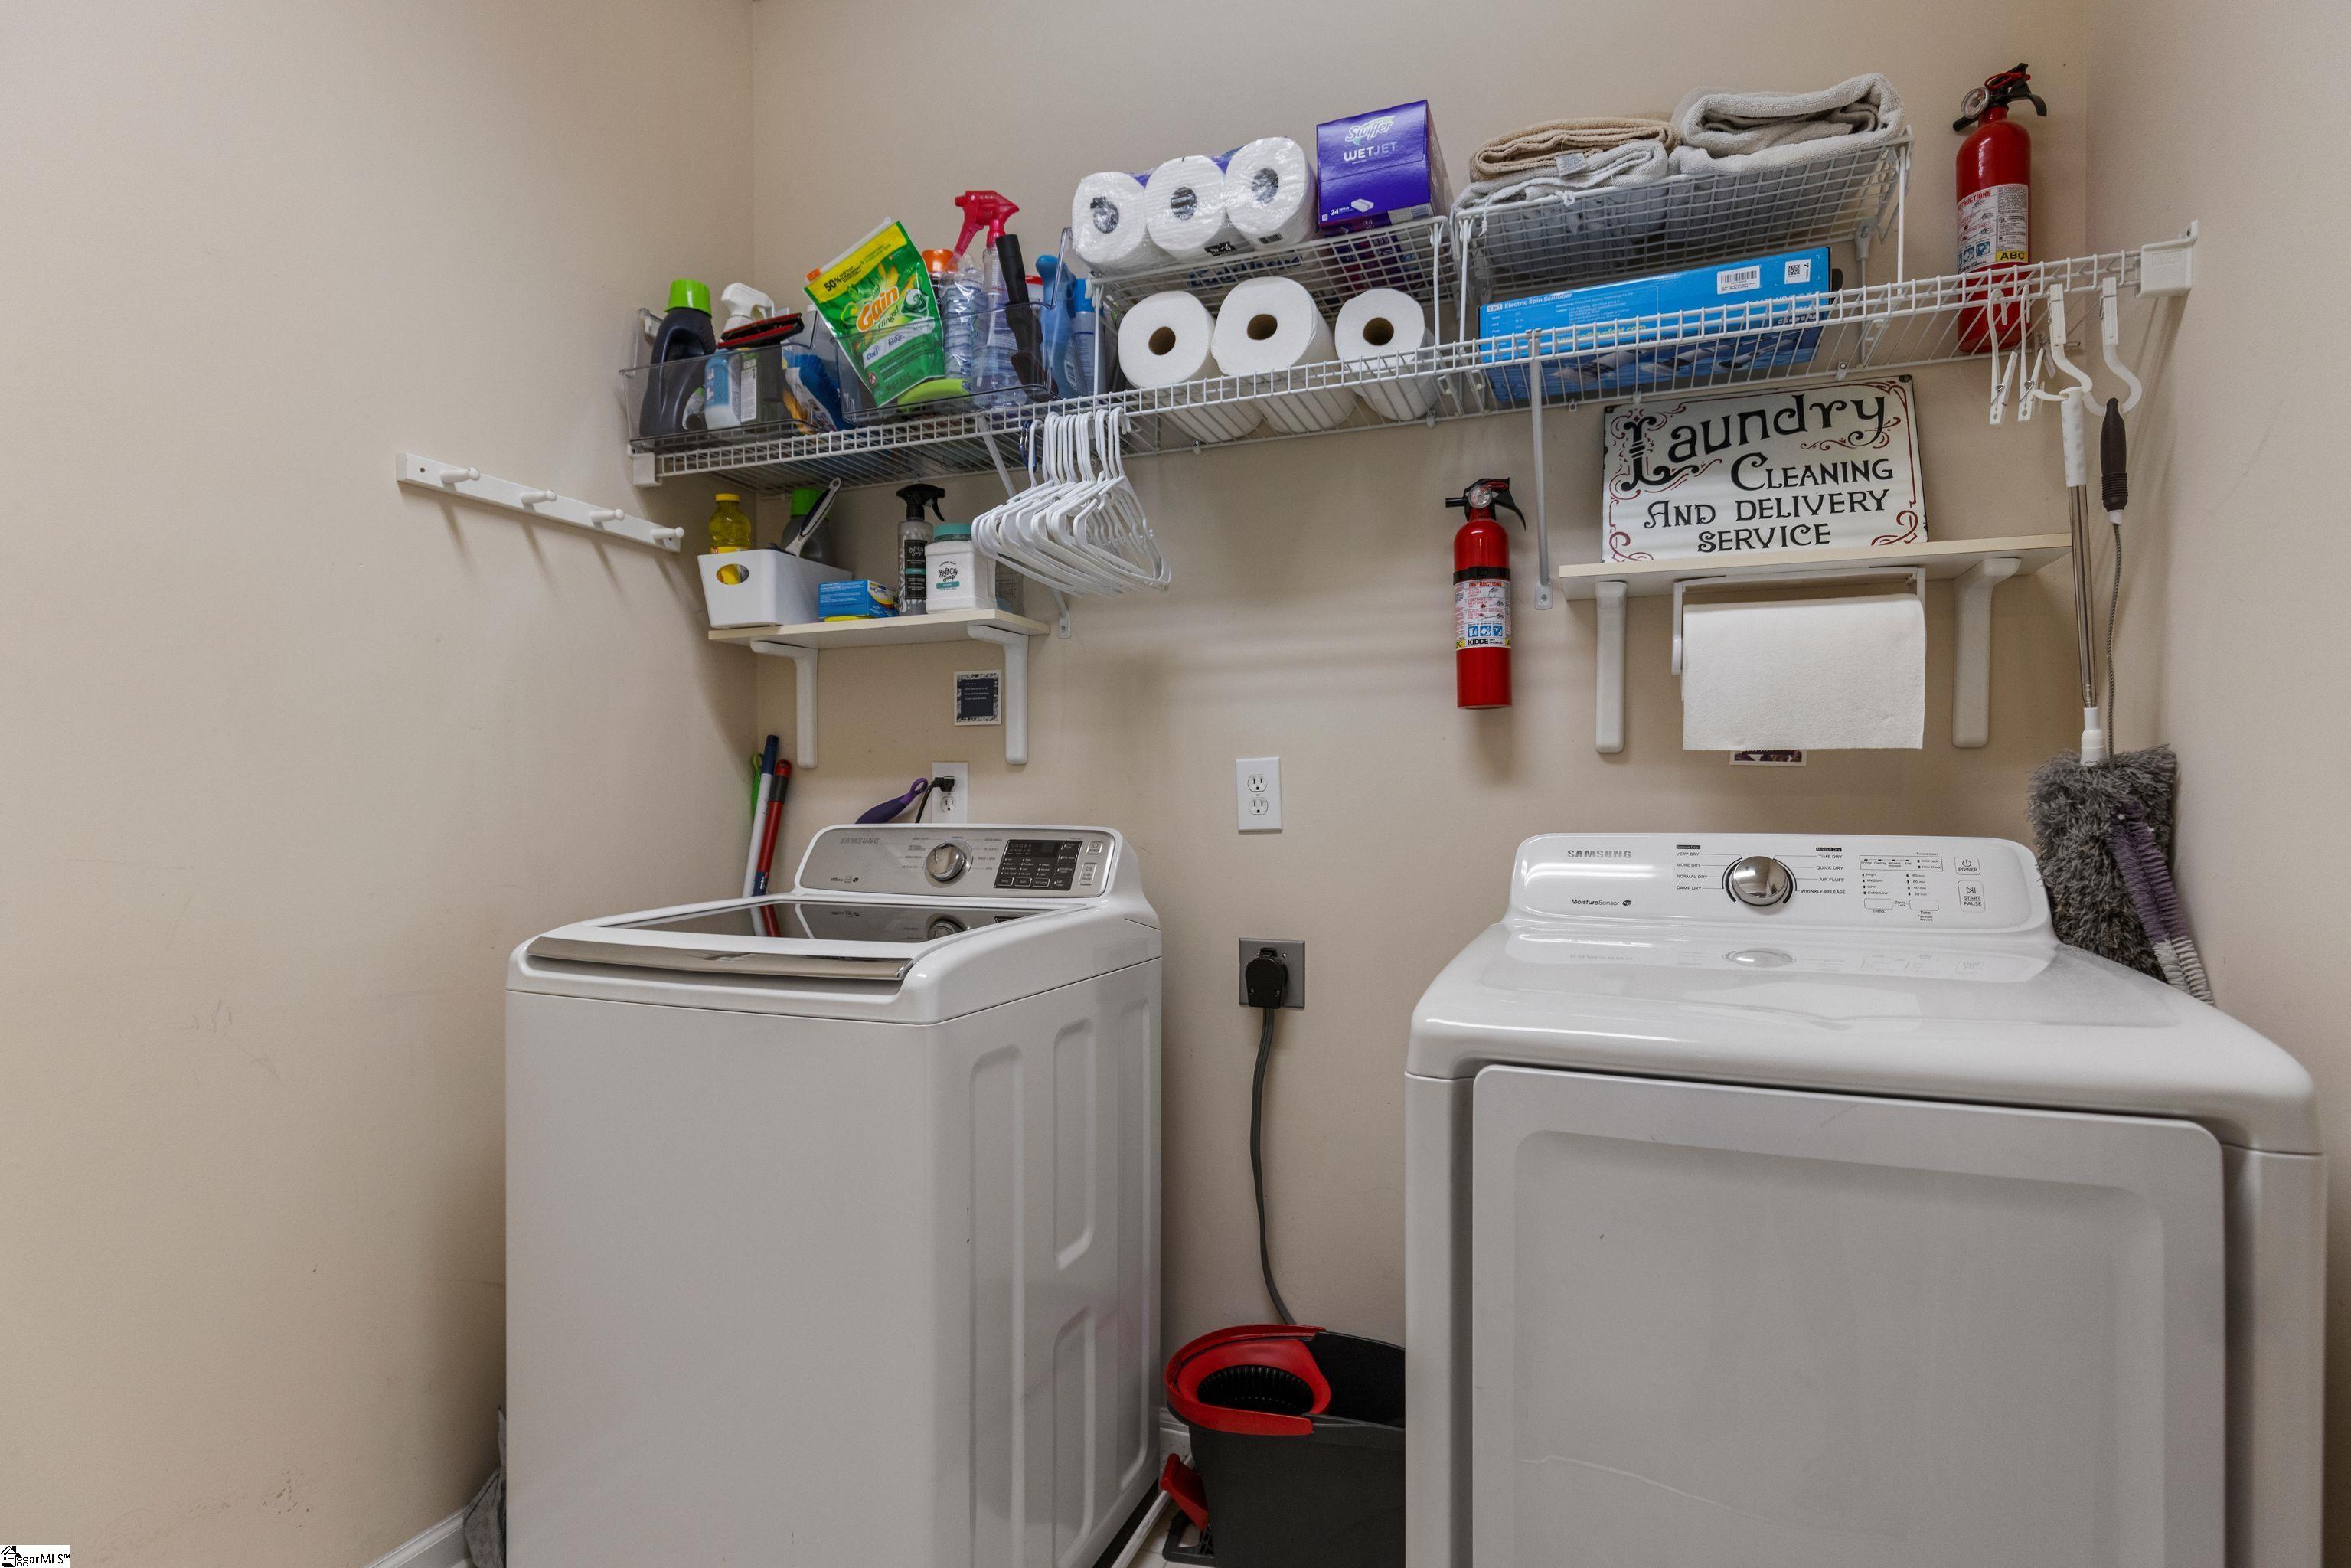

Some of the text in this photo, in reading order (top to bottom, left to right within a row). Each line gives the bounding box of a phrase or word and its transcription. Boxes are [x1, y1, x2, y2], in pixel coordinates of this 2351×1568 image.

[1345, 119, 1394, 142] Swiffer
[1344, 142, 1398, 162] WETJET
[2000, 252, 2024, 260] ABC
[857, 287, 899, 331] Gain
[1504, 300, 1527, 309] Electric
[1543, 293, 1572, 302] Scrubber
[1621, 394, 1886, 492] Laundry
[1644, 488, 1890, 529] AND DELIVERY
[1696, 523, 1831, 553] SERVICE
[939, 567, 949, 578] Buff
[1567, 850, 1631, 858] SAMSUNG
